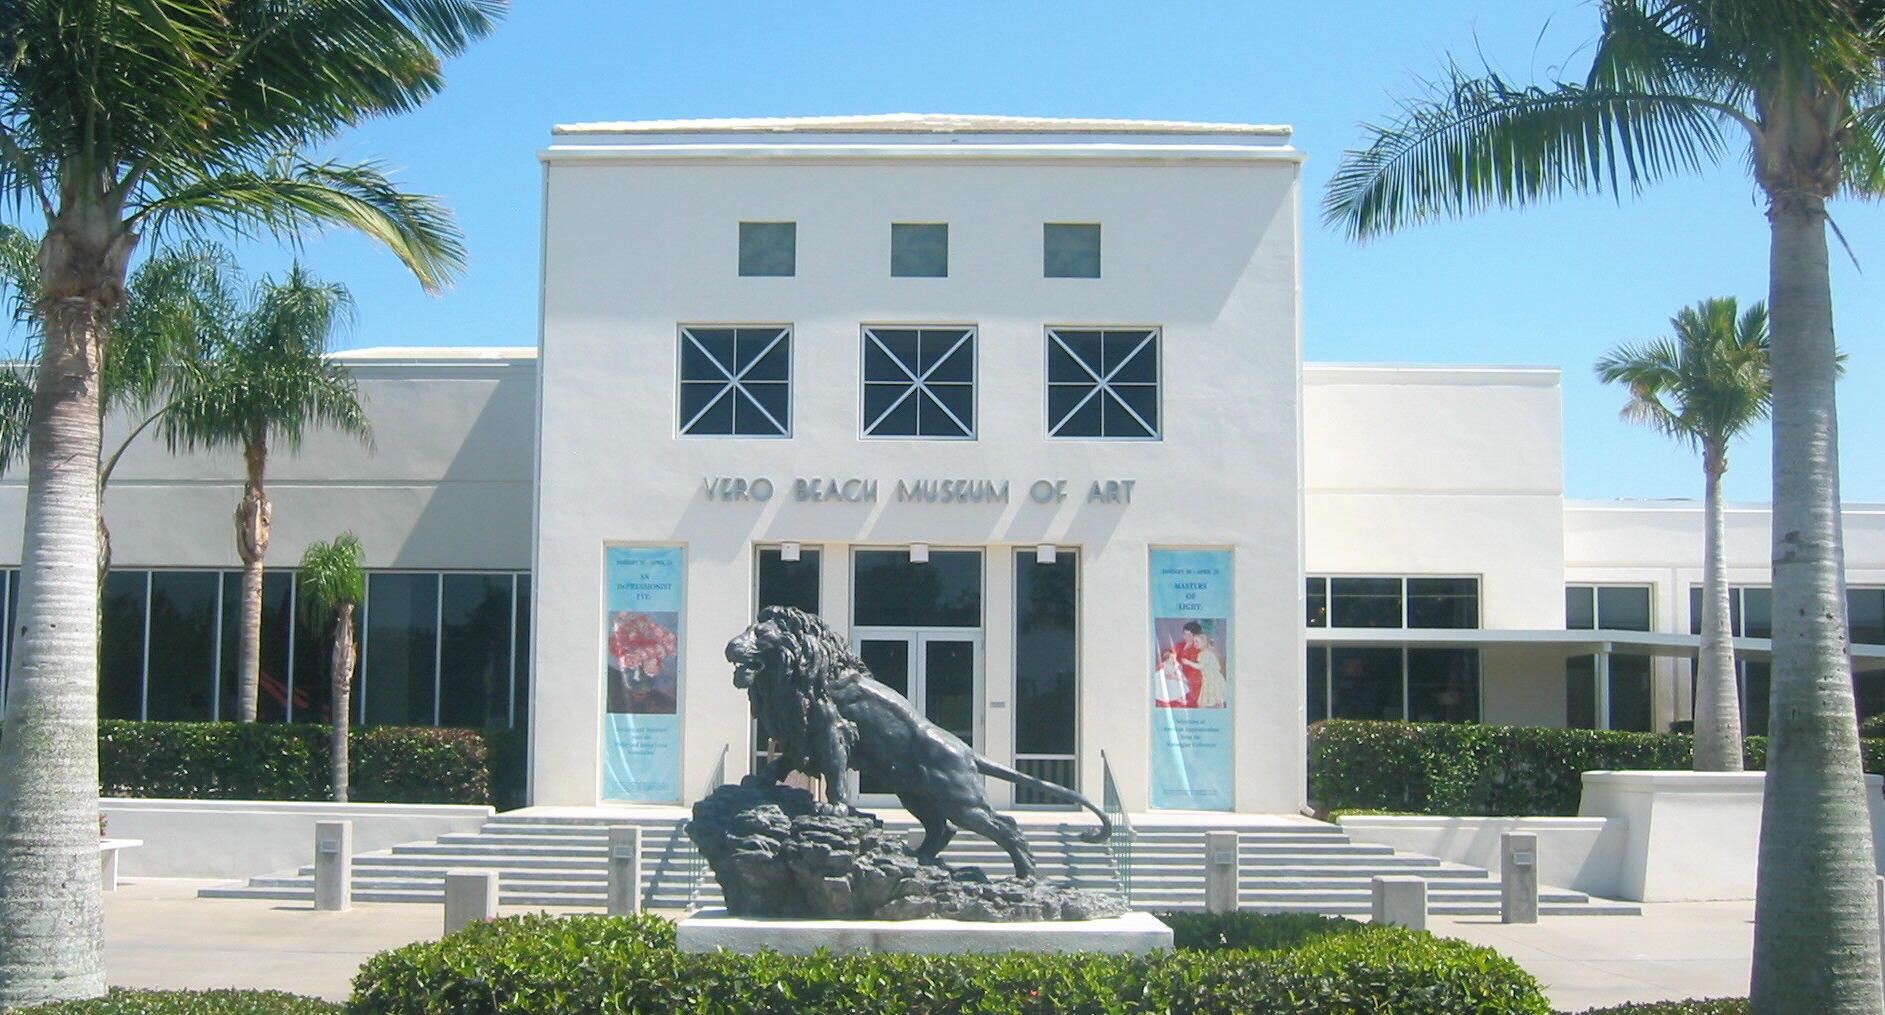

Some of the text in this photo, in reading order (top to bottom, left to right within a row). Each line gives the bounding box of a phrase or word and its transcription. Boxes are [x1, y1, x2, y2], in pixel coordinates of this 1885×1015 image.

[704, 477, 1136, 504] VERO BEACH MUSEUM OF ART
